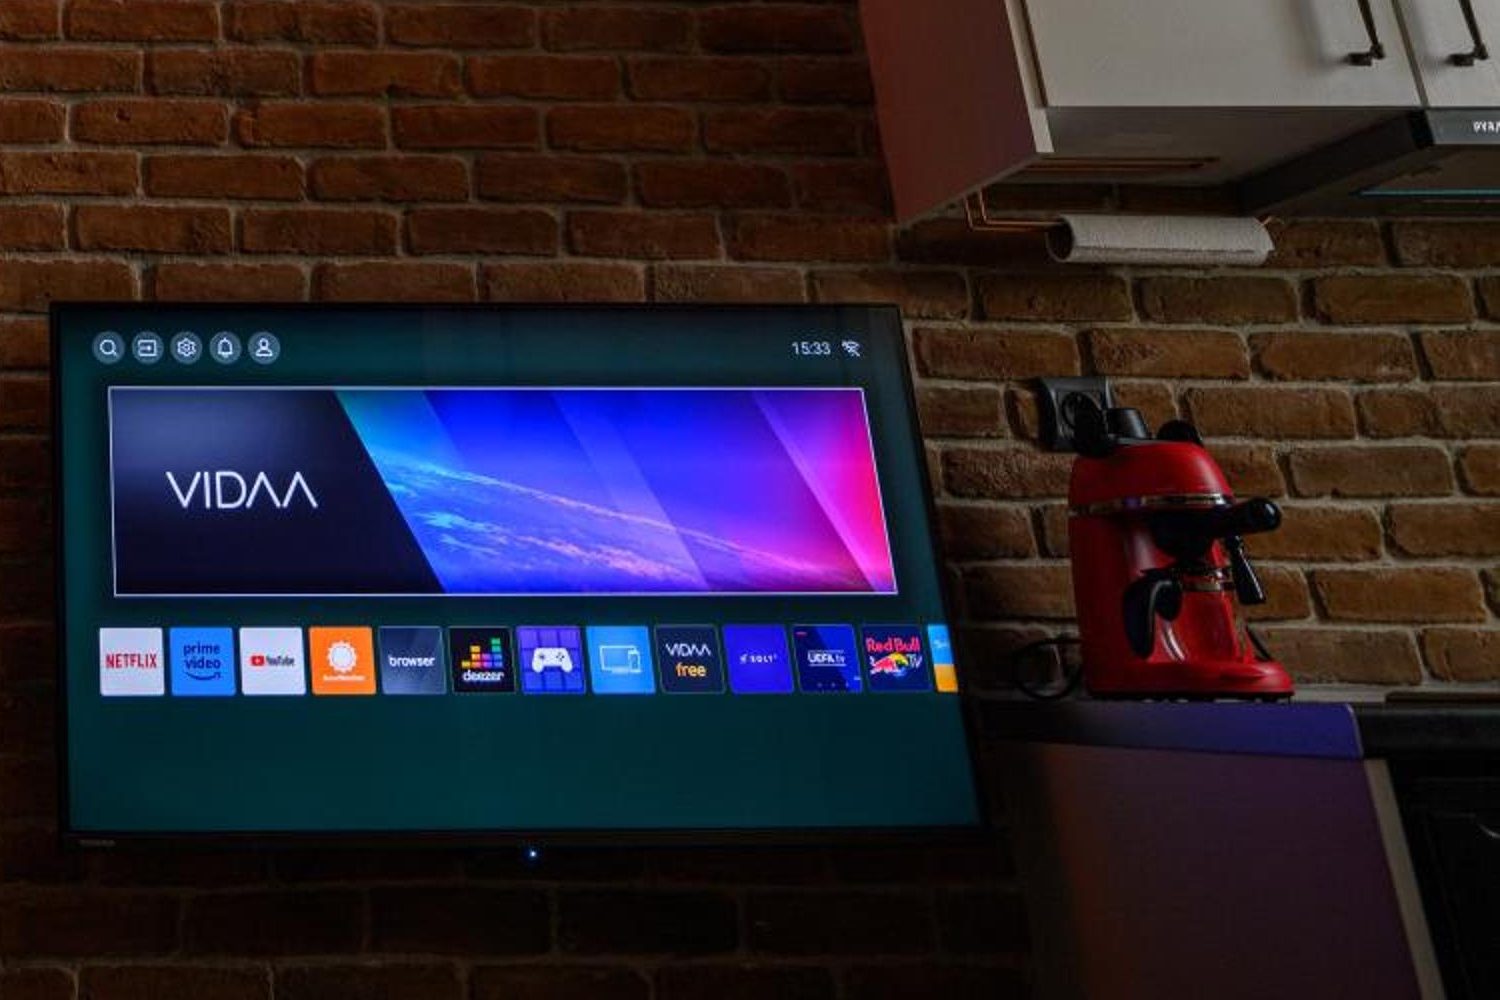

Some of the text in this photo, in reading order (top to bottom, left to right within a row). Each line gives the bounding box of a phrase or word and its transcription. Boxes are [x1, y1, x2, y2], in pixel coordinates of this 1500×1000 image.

[791, 341, 831, 355] 15:33
[165, 470, 319, 509] VIDAA
[183, 643, 220, 656] prime
[665, 643, 711, 656] VIDAA
[865, 636, 892, 652] Red
[893, 635, 921, 652] Bull
[106, 653, 157, 668] NETFLIX
[184, 656, 221, 670] video
[265, 656, 295, 667] YouTube
[388, 654, 435, 667] browser
[906, 653, 923, 669] TV
[462, 669, 504, 682] deezer
[675, 662, 707, 678] free
